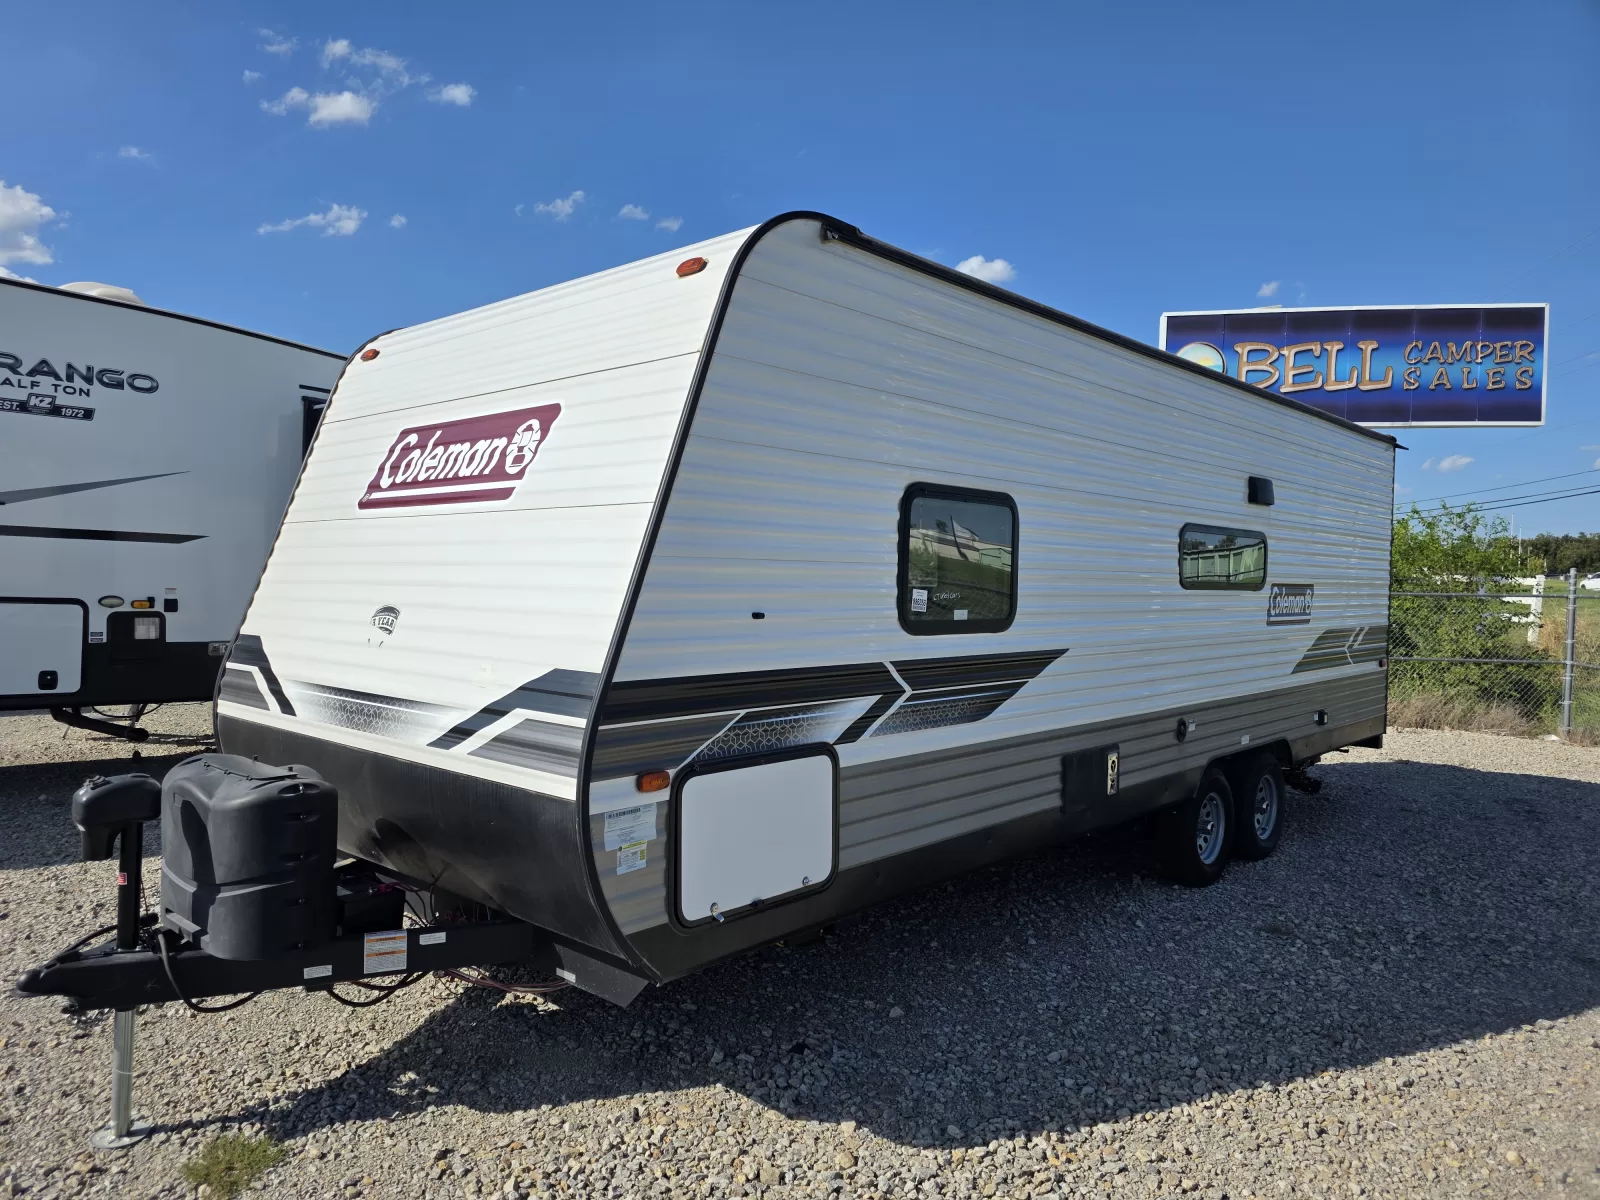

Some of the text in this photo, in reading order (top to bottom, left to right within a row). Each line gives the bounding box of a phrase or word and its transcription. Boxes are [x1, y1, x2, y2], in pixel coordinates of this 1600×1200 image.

[1403, 340, 1535, 364] CAMPER
[1234, 341, 1393, 393] BELL
[1403, 366, 1533, 390] SALES
[51, 384, 90, 397] TON
[29, 395, 53, 408] KZ
[60, 408, 85, 418] 1972
[379, 430, 508, 489] Coleman
[1271, 587, 1304, 615] Coleman
[378, 616, 395, 629] YEAR
